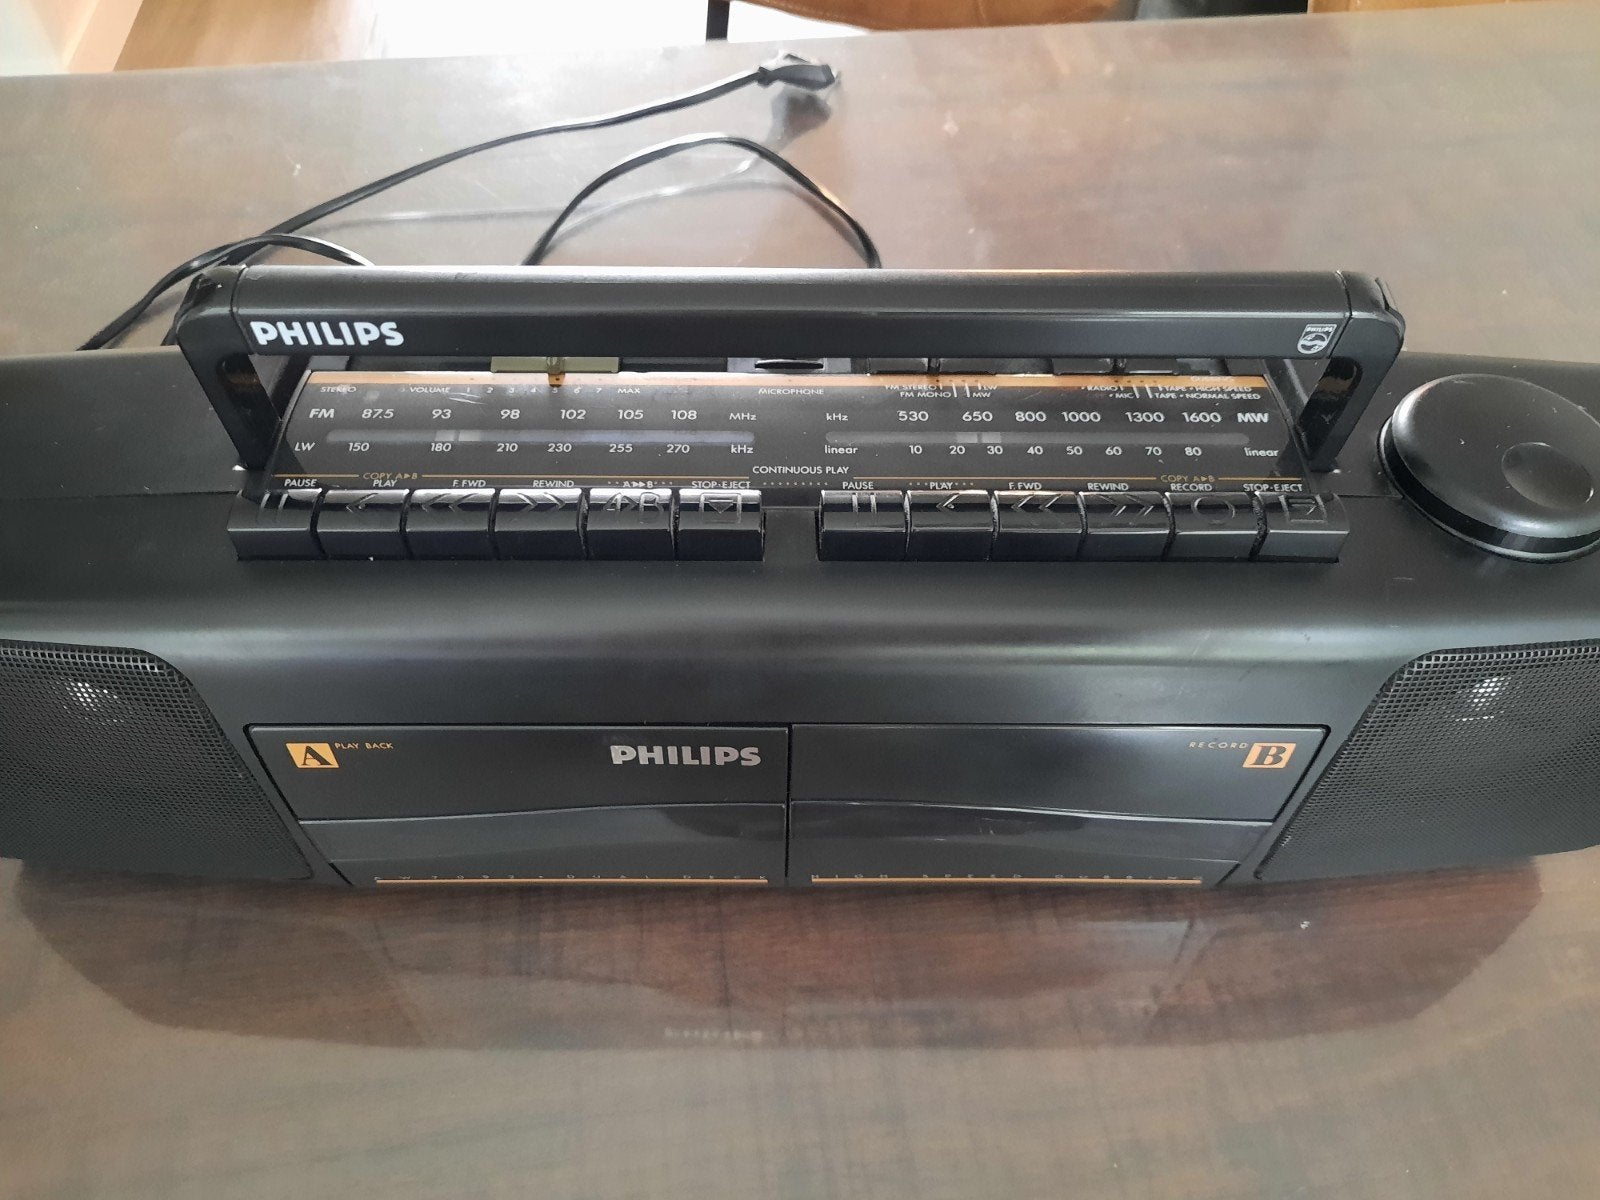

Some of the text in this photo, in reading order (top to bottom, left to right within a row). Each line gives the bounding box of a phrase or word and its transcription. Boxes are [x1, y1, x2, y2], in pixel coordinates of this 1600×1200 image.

[250, 321, 405, 346] PHILIPS
[309, 408, 757, 421] FM 87.5 93 98 102 105 108 MHz
[826, 411, 1270, 423] kHz 530 650 800 1000 1300 1600 MW
[294, 443, 754, 454] LW 150 180 210 230 255 270 kHz
[824, 445, 1278, 457] linear 10 20 30 40 50 60 70 80 linear
[752, 466, 849, 475] CONTINUOUS PLAY
[363, 472, 393, 480] COPY
[1160, 475, 1190, 483] COPY
[284, 479, 317, 487] PAUSE
[373, 479, 398, 487] PLAY
[533, 480, 575, 488] REWIND
[842, 481, 874, 490] PAUSE
[929, 481, 954, 490] PLAY
[1087, 483, 1129, 491] REWIND
[1170, 483, 1213, 492] RECORD
[301, 742, 394, 766] A PLAY BACK
[610, 745, 762, 766] PHILIPS
[1188, 741, 1287, 766] RECORD B
